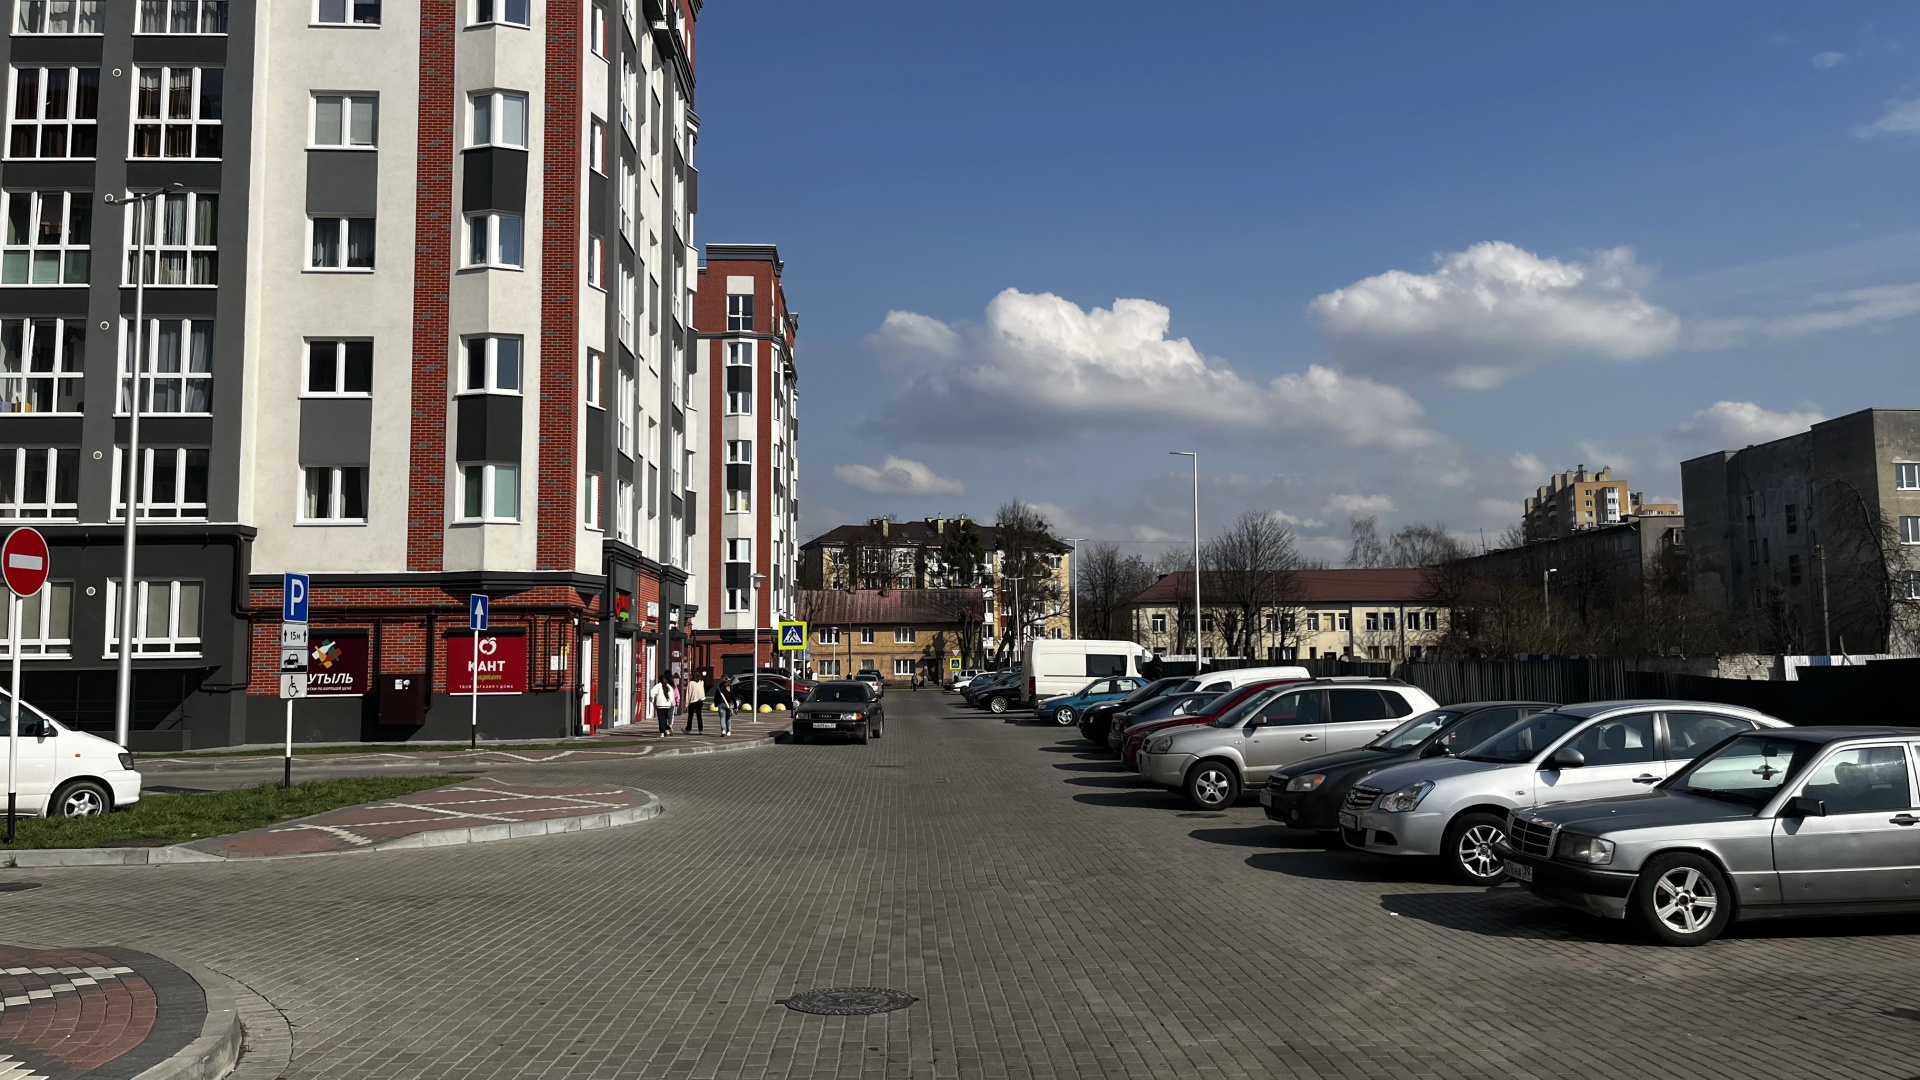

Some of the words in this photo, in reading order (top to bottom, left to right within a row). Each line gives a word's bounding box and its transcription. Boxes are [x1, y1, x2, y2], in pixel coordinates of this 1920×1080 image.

[290, 578, 305, 616] P
[467, 660, 506, 672] КАНТ
[307, 673, 354, 684] УТЫЛЬ
[470, 674, 502, 683] аркет
